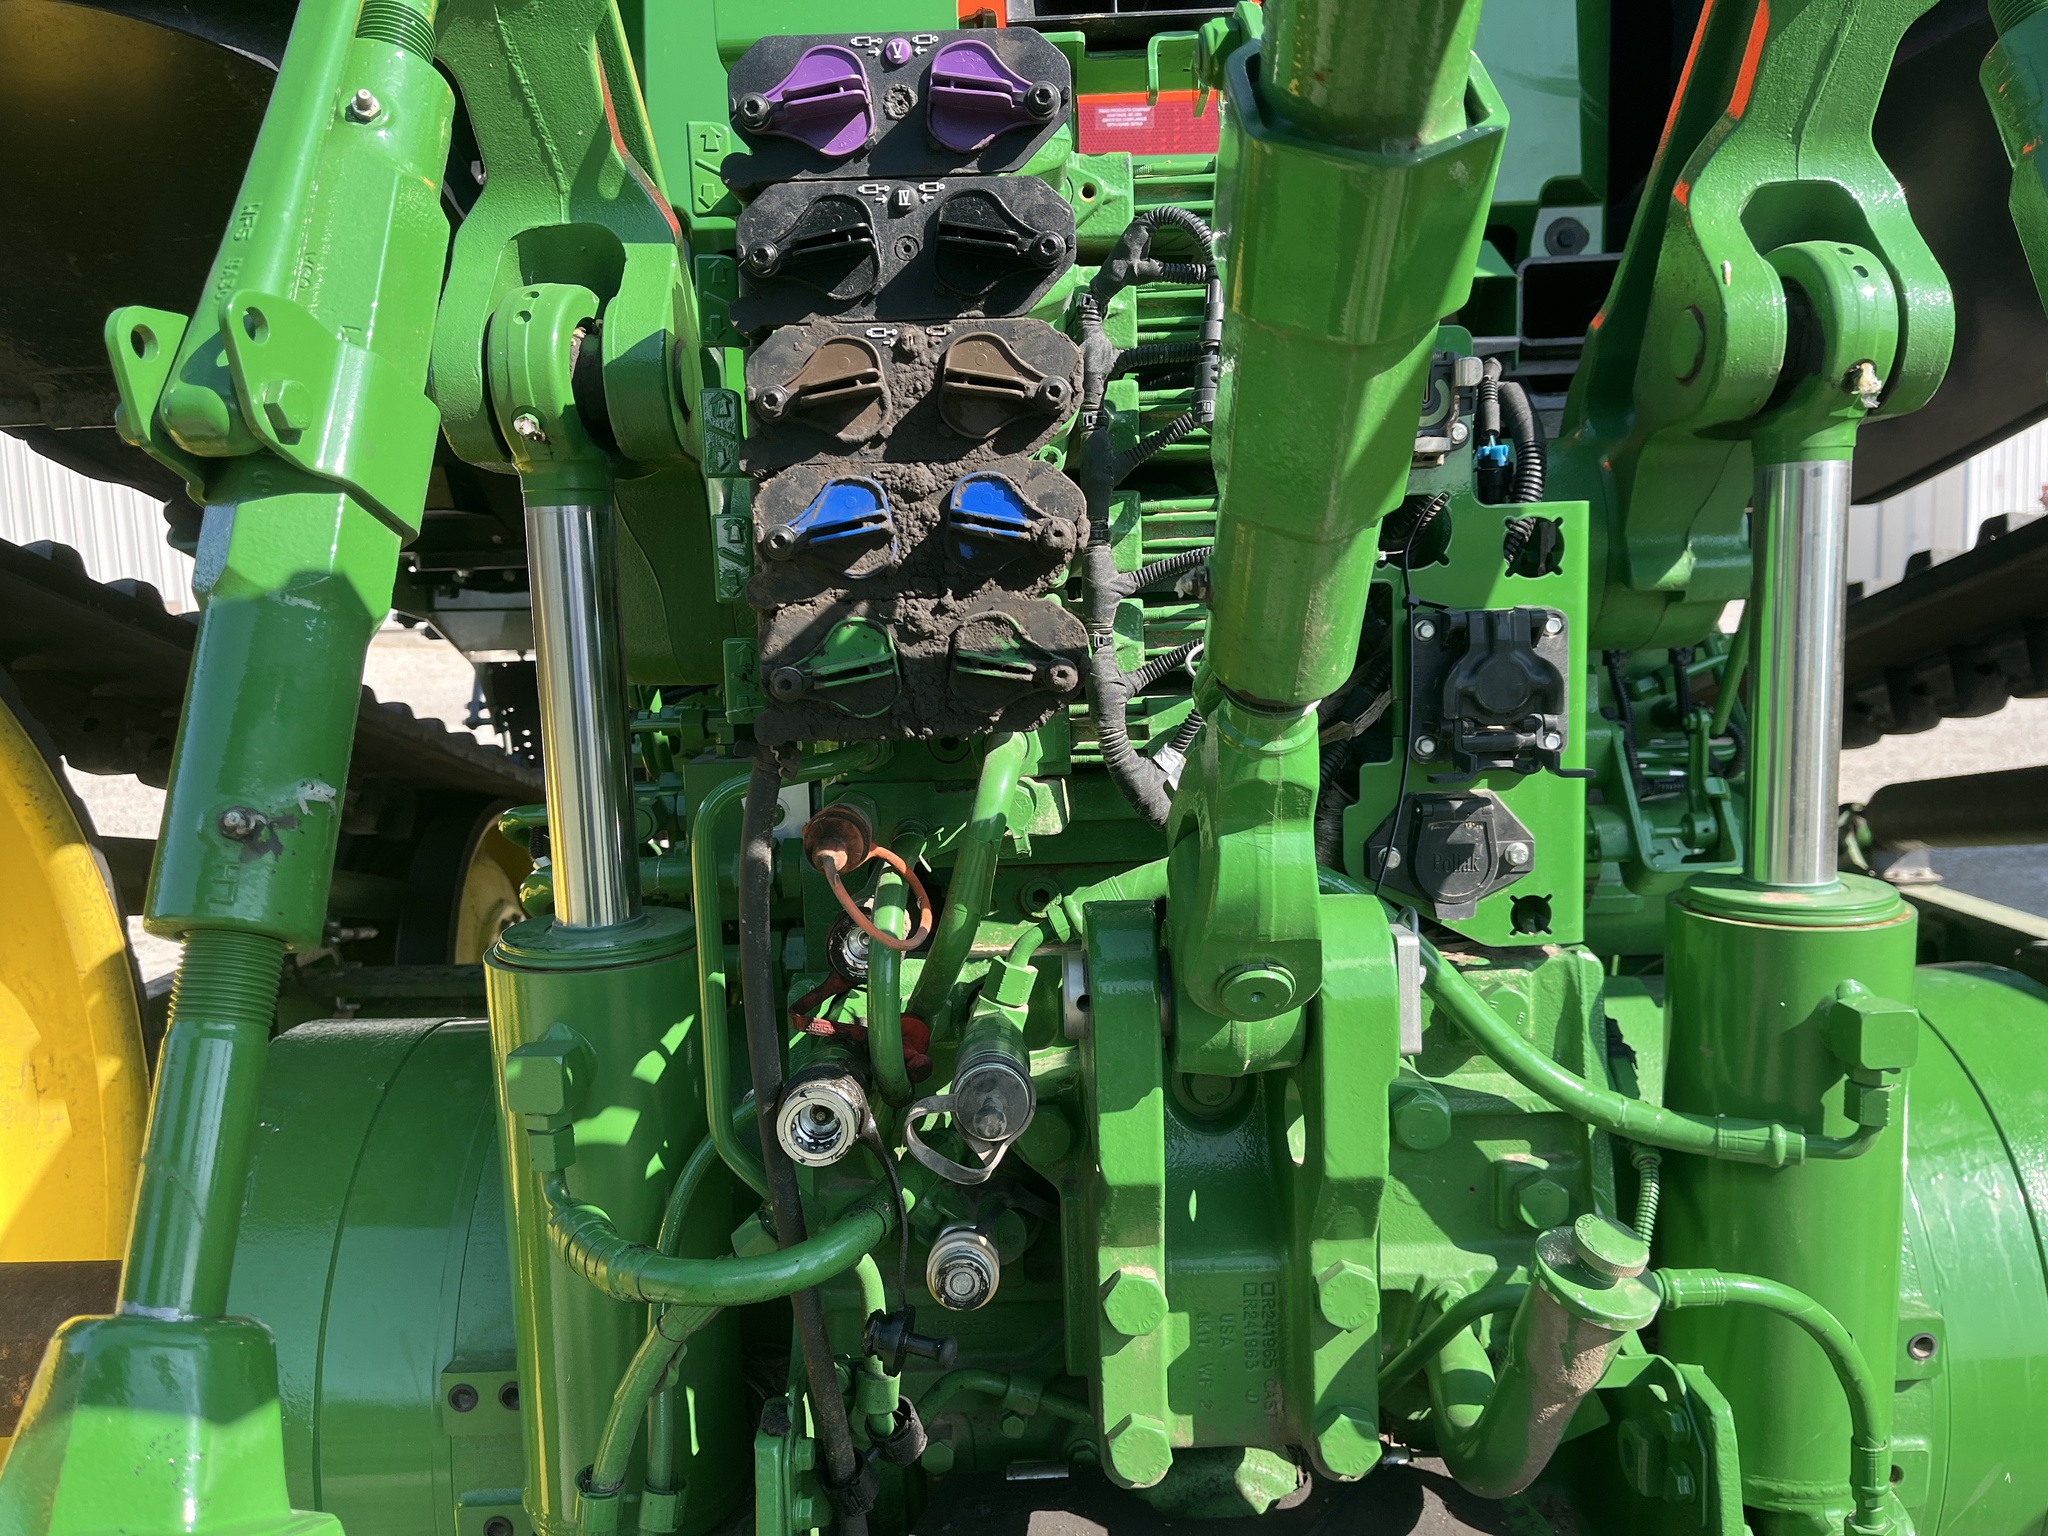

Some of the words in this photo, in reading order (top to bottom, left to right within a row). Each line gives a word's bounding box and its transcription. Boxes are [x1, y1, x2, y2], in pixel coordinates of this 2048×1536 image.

[891, 41, 904, 59] V
[898, 189, 911, 206] IV
[1433, 851, 1480, 873] Pollak
[1219, 1313, 1235, 1349] USA
